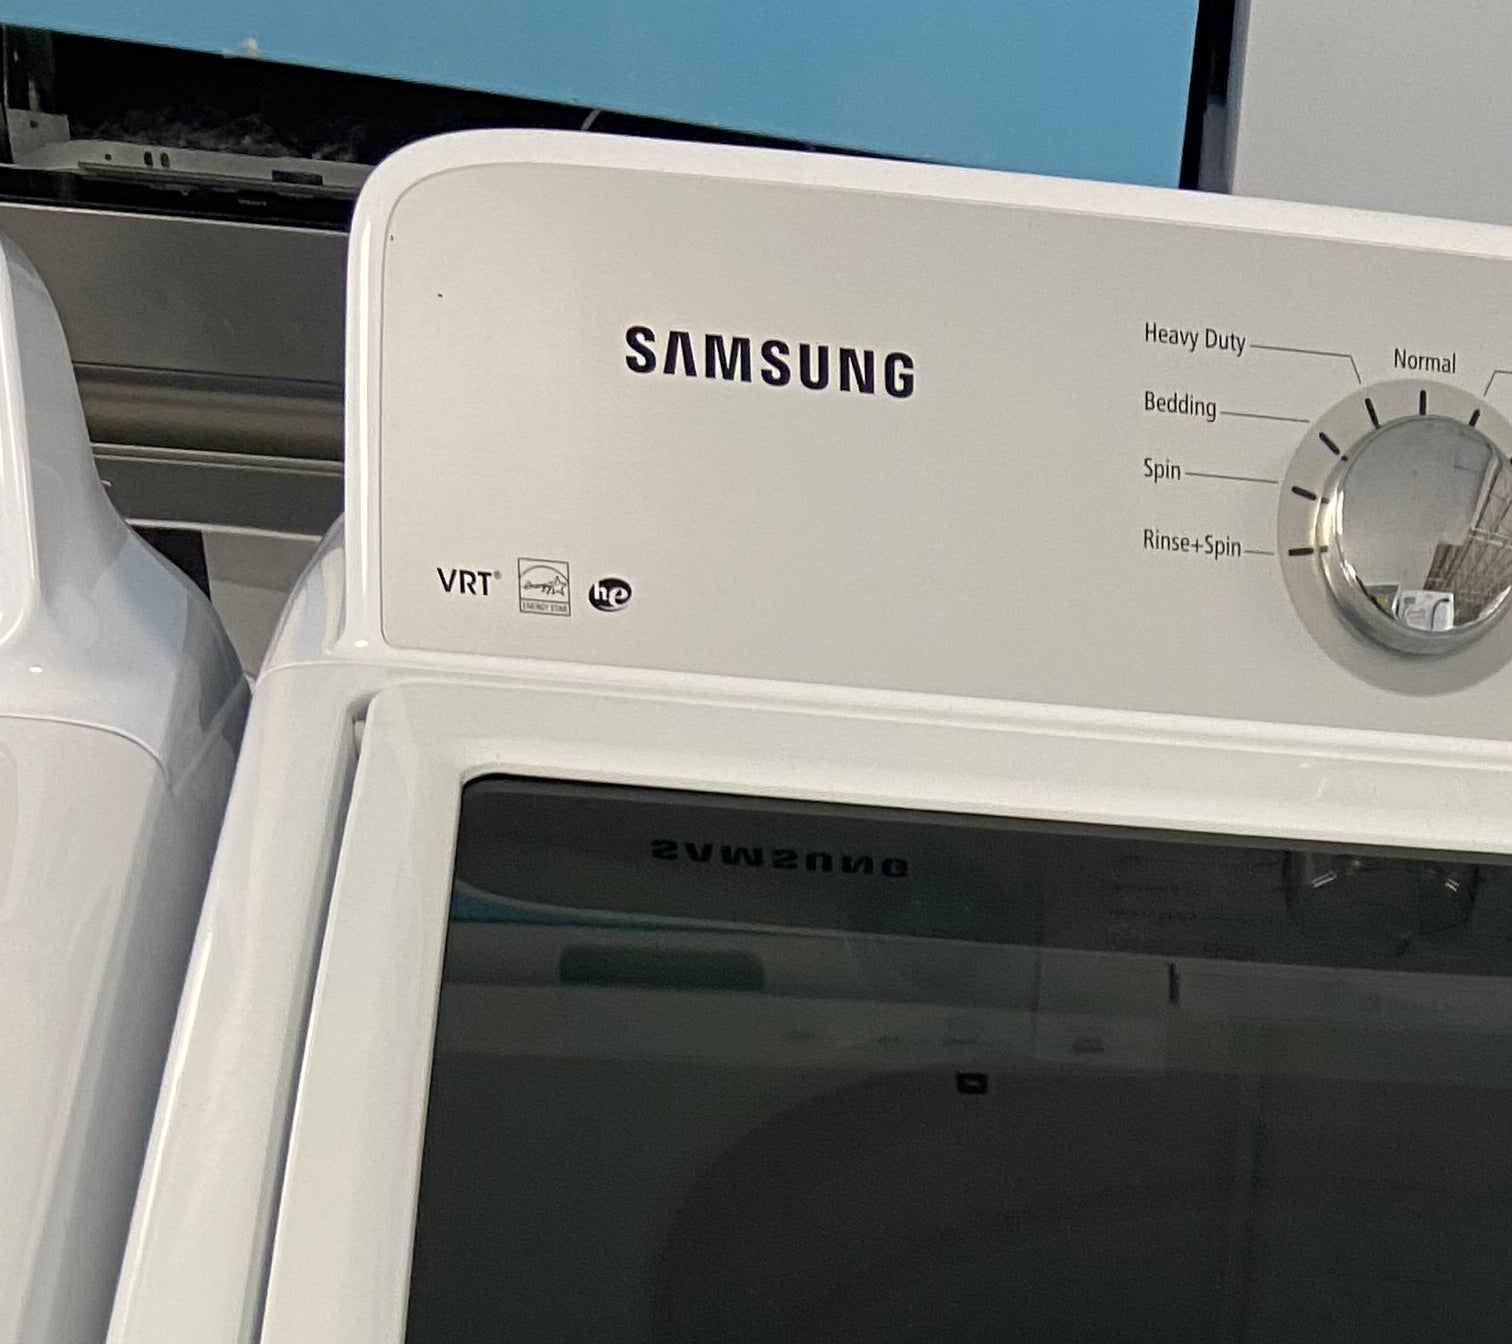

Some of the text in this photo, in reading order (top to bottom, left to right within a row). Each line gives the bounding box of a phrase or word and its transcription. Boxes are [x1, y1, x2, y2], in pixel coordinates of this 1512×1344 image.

[1145, 323, 1246, 356] Heavy Duty
[624, 325, 917, 399] SAMSUNG
[1395, 348, 1456, 374] Normal
[1145, 391, 1217, 422] Bedding
[1144, 457, 1181, 486] Spin
[1144, 528, 1241, 562] Rinse+Spin
